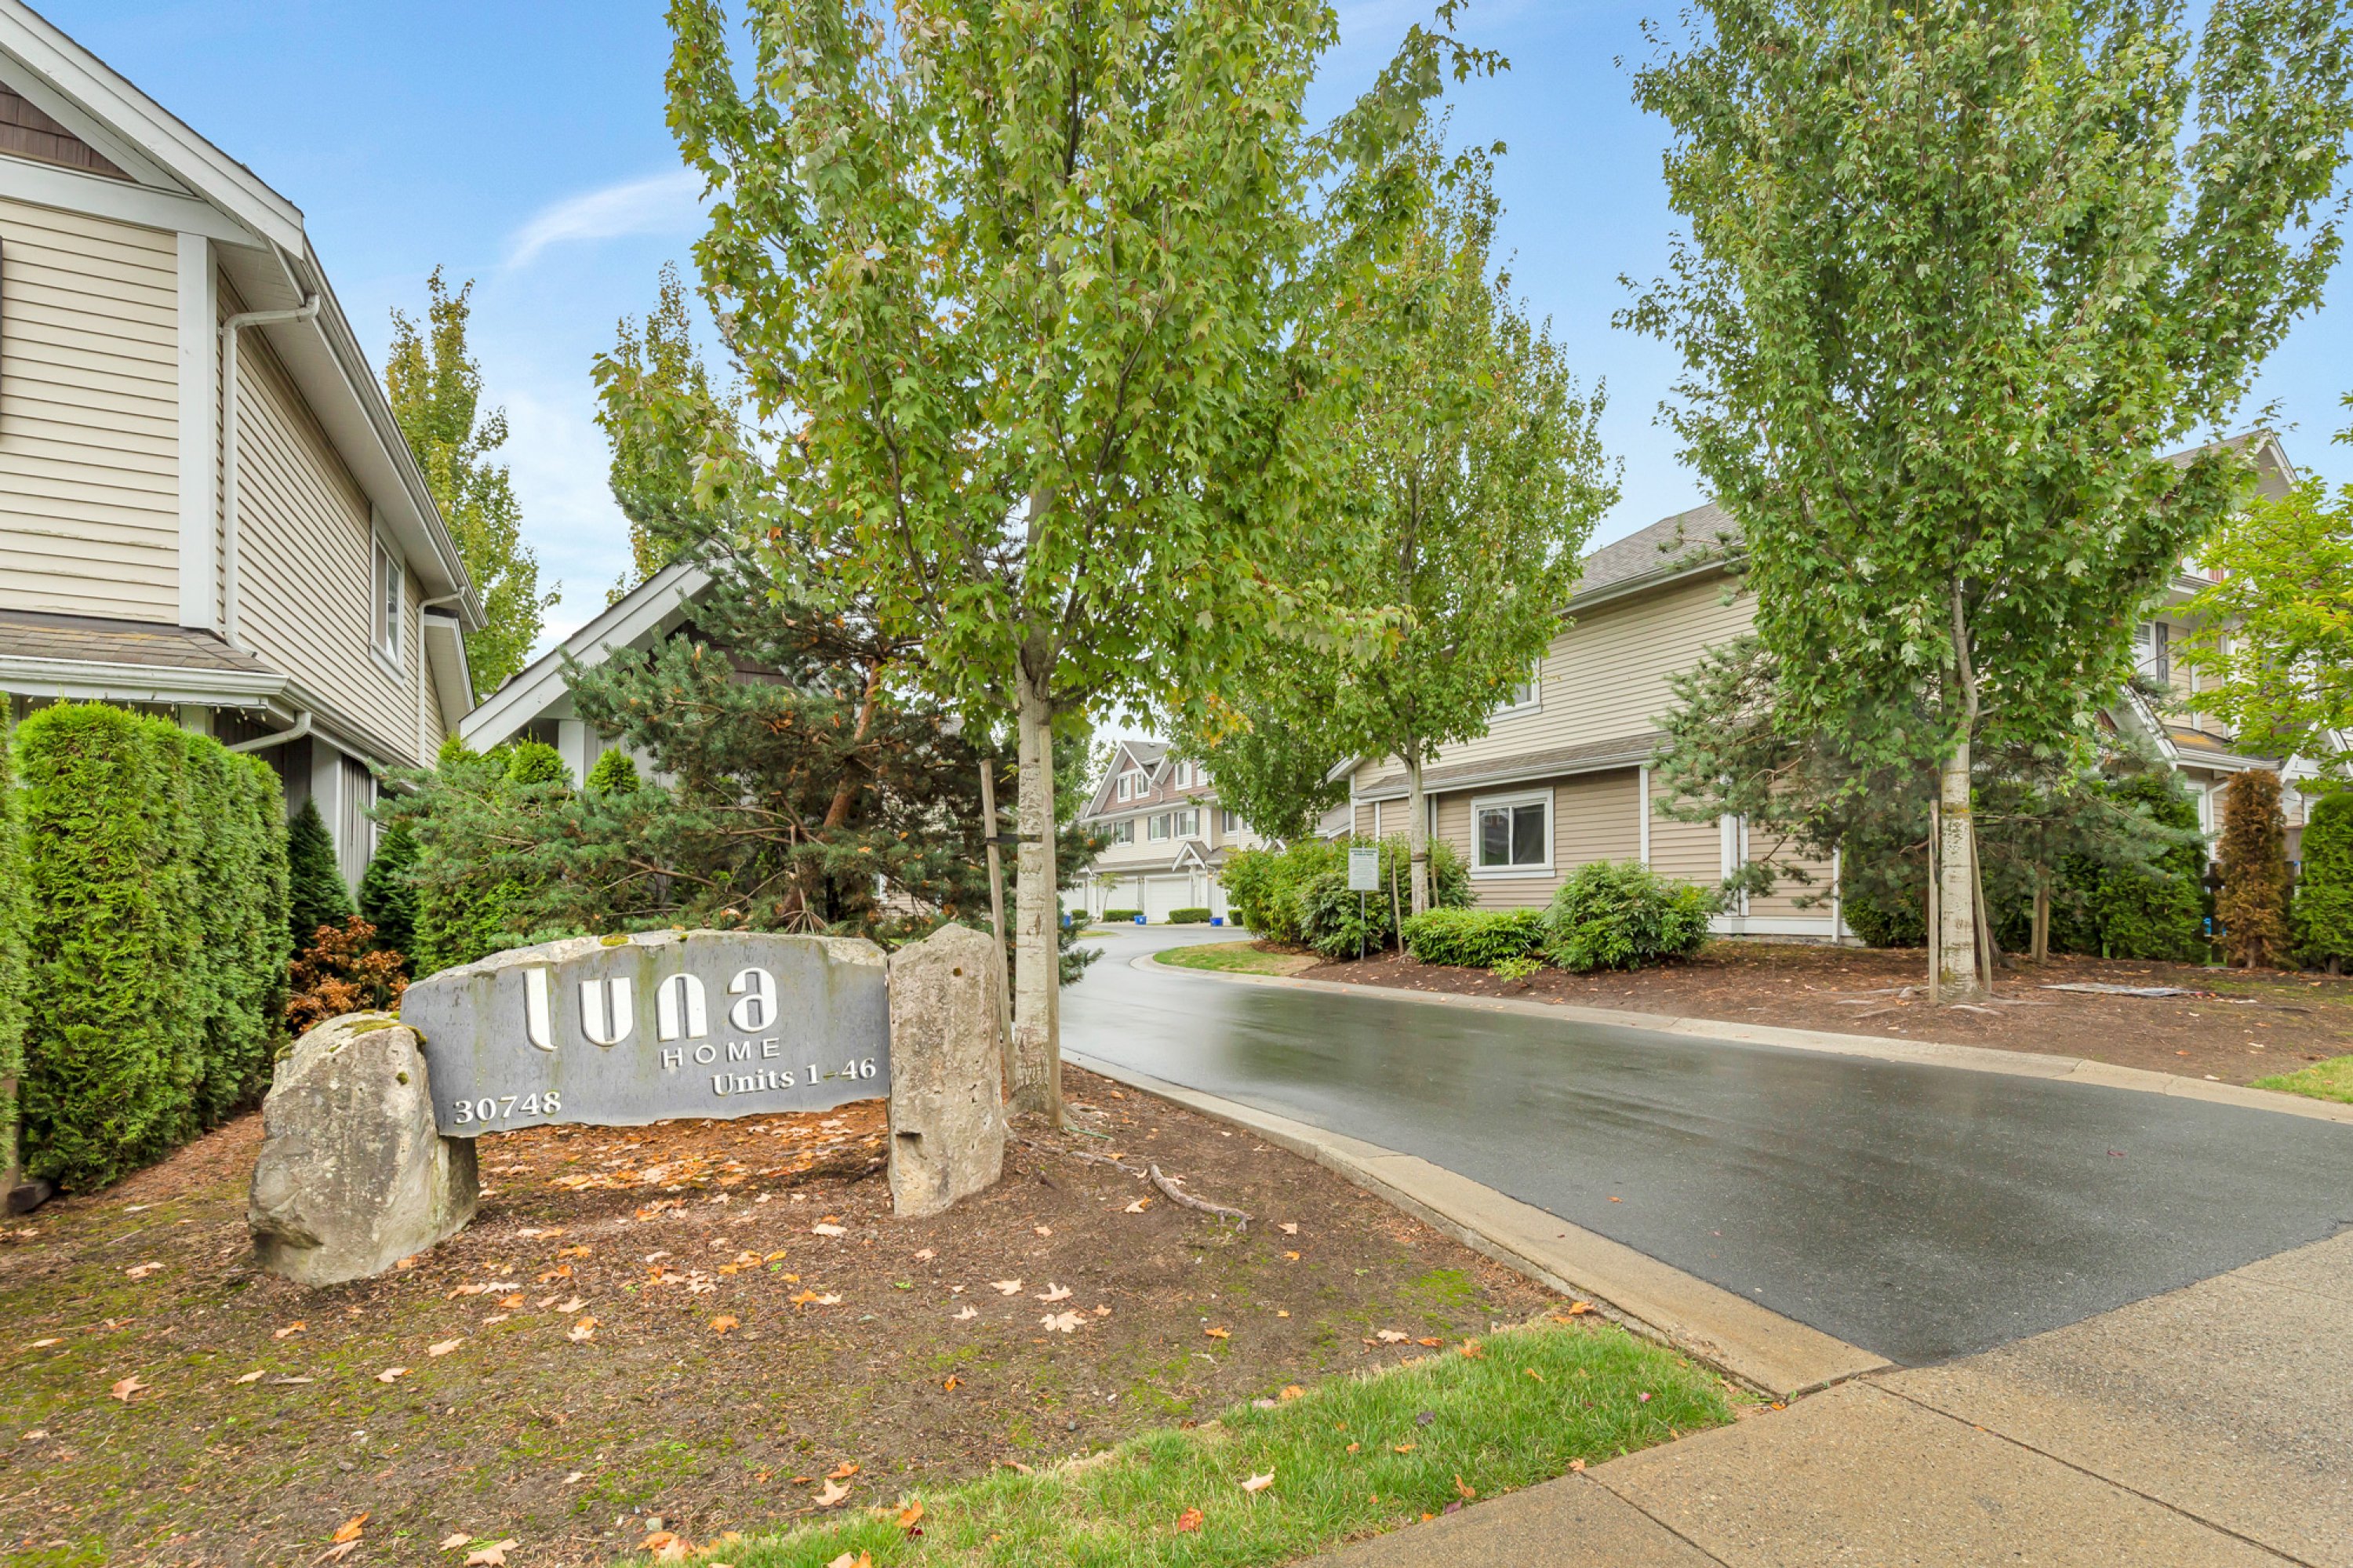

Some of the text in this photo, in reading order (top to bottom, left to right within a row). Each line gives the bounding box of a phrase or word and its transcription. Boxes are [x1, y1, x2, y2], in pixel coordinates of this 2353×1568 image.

[525, 966, 777, 1050] luna
[663, 1038, 780, 1068] HOME
[712, 1068, 795, 1096] Units
[455, 1091, 562, 1124] 30748
